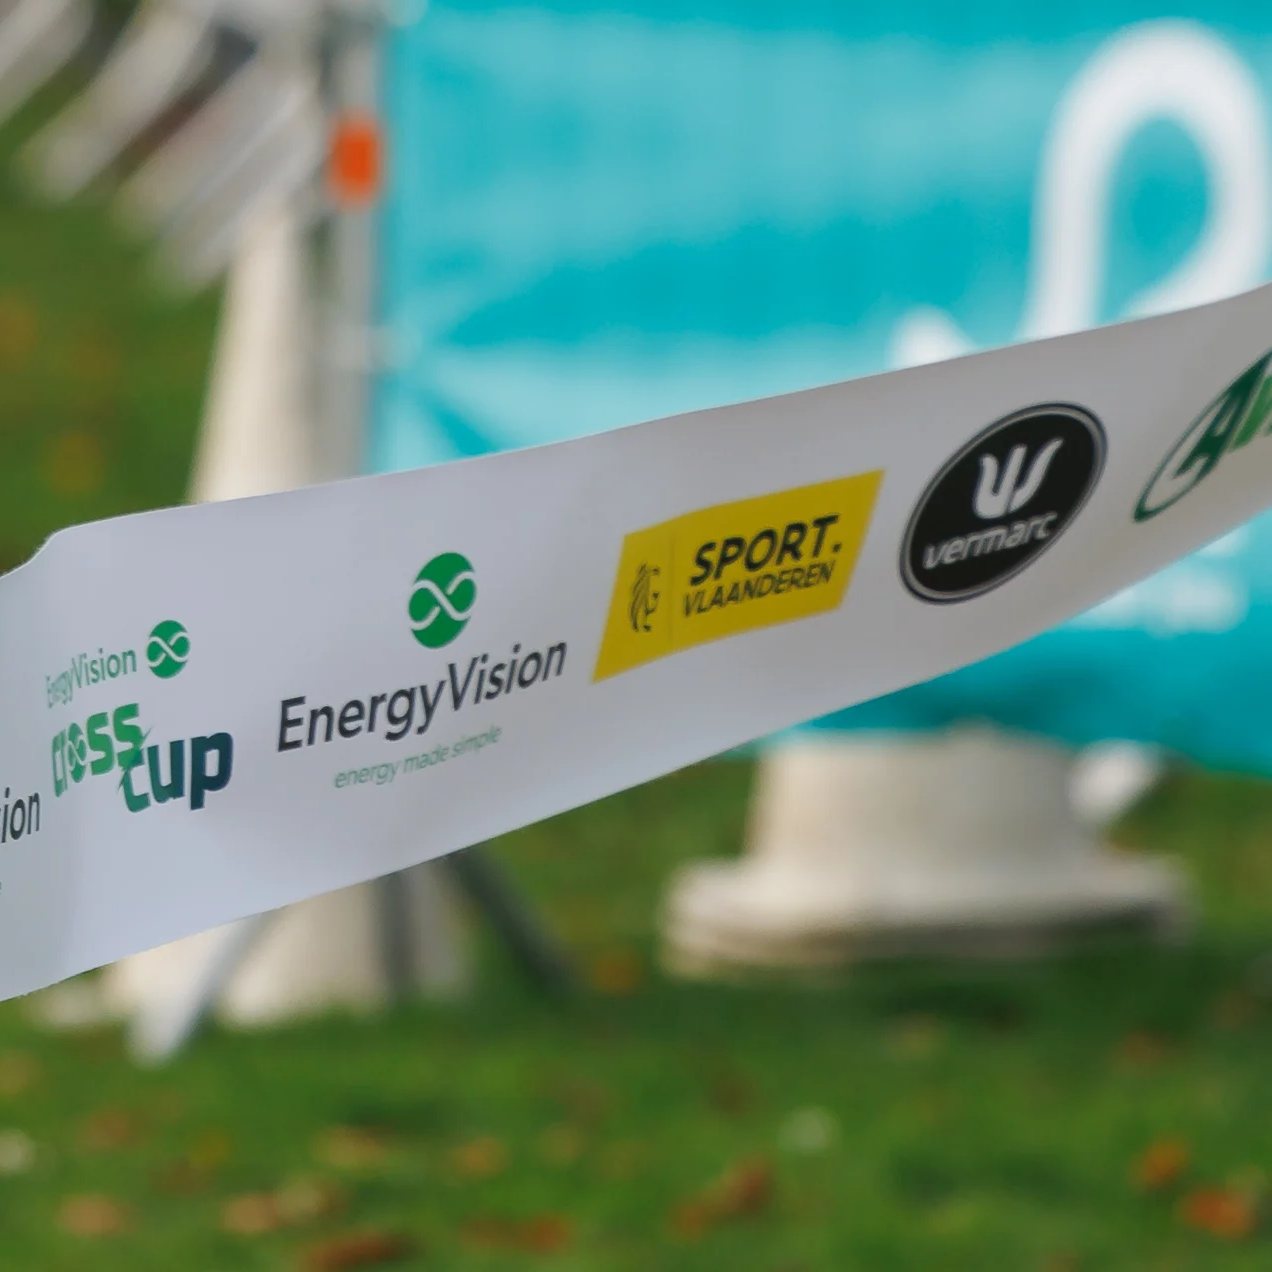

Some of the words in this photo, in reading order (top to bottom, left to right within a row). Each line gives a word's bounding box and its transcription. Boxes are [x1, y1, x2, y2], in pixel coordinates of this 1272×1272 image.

[690, 513, 843, 588] SPORT.
[923, 510, 1060, 570] vermarc
[683, 559, 837, 618] VLAANDEREN
[45, 647, 138, 710] EgyVision
[277, 639, 568, 754] EnergyVision
[119, 731, 234, 813] cup
[333, 761, 399, 789] energy
[402, 743, 449, 775] made
[451, 724, 503, 757] simple
